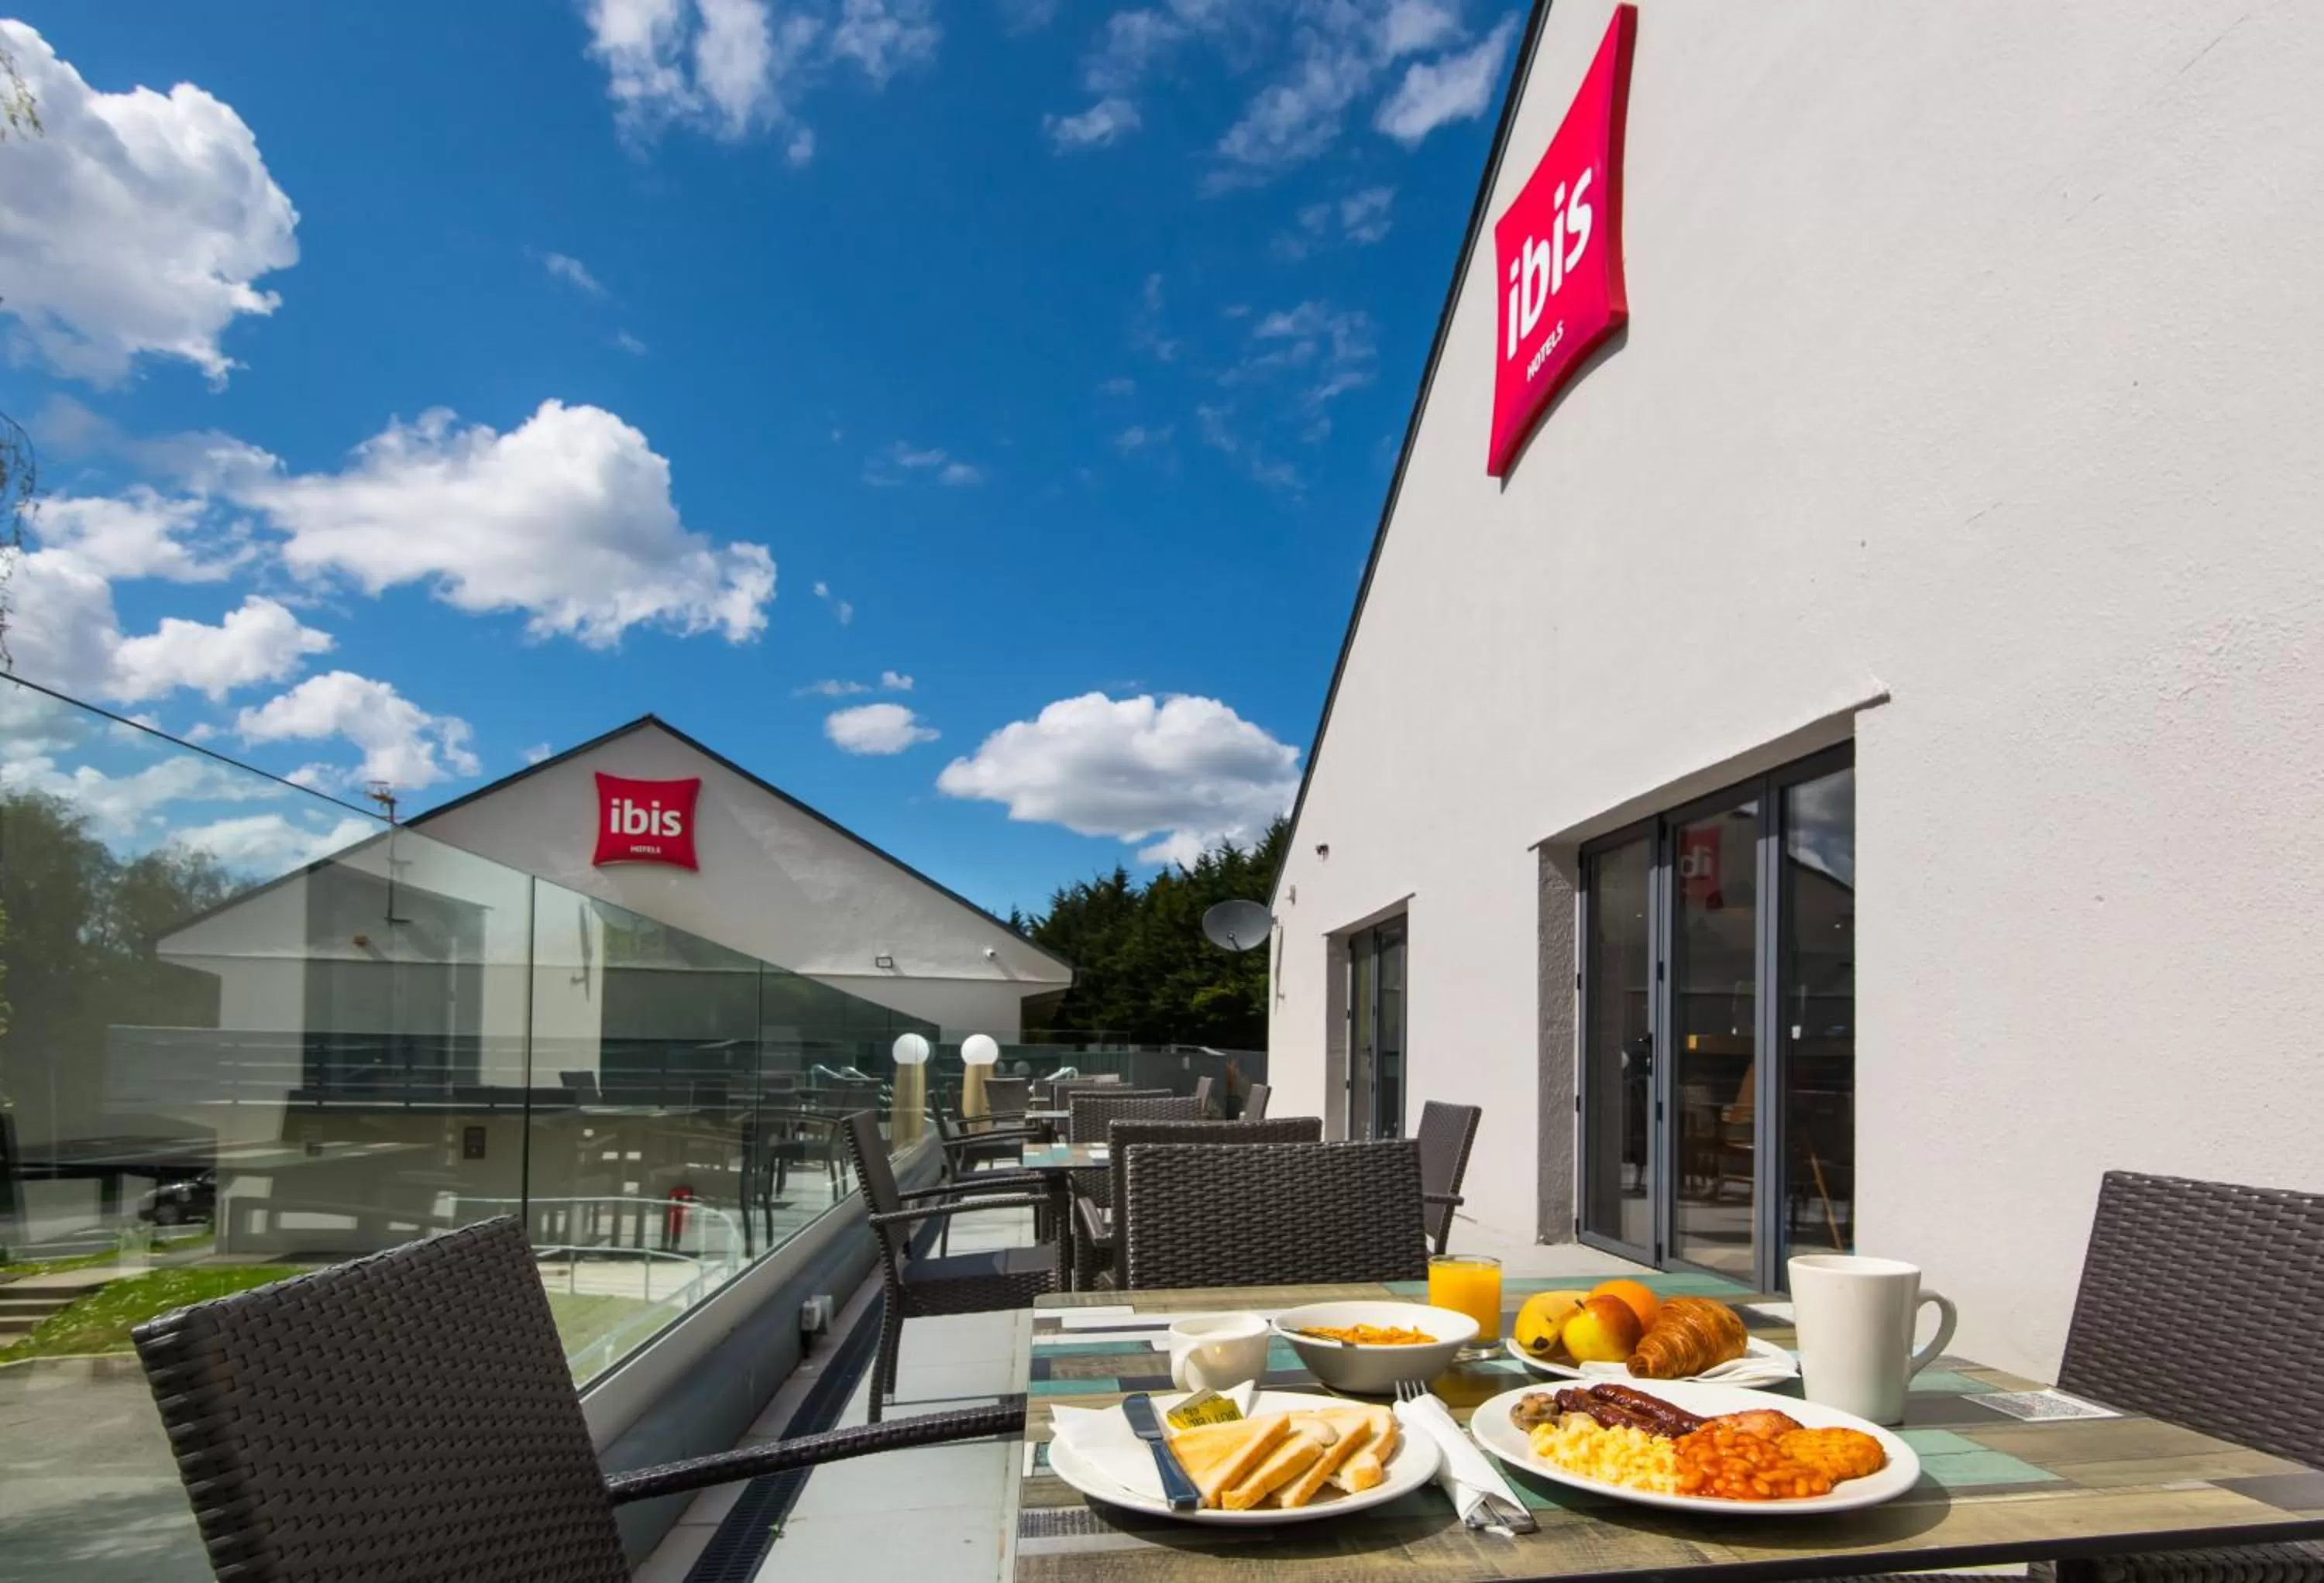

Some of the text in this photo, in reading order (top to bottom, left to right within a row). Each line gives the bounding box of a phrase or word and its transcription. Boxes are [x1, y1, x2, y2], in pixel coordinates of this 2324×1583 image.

[1507, 167, 1593, 360] ibis
[1527, 318, 1564, 382] HOTELS
[610, 797, 682, 837] ibis
